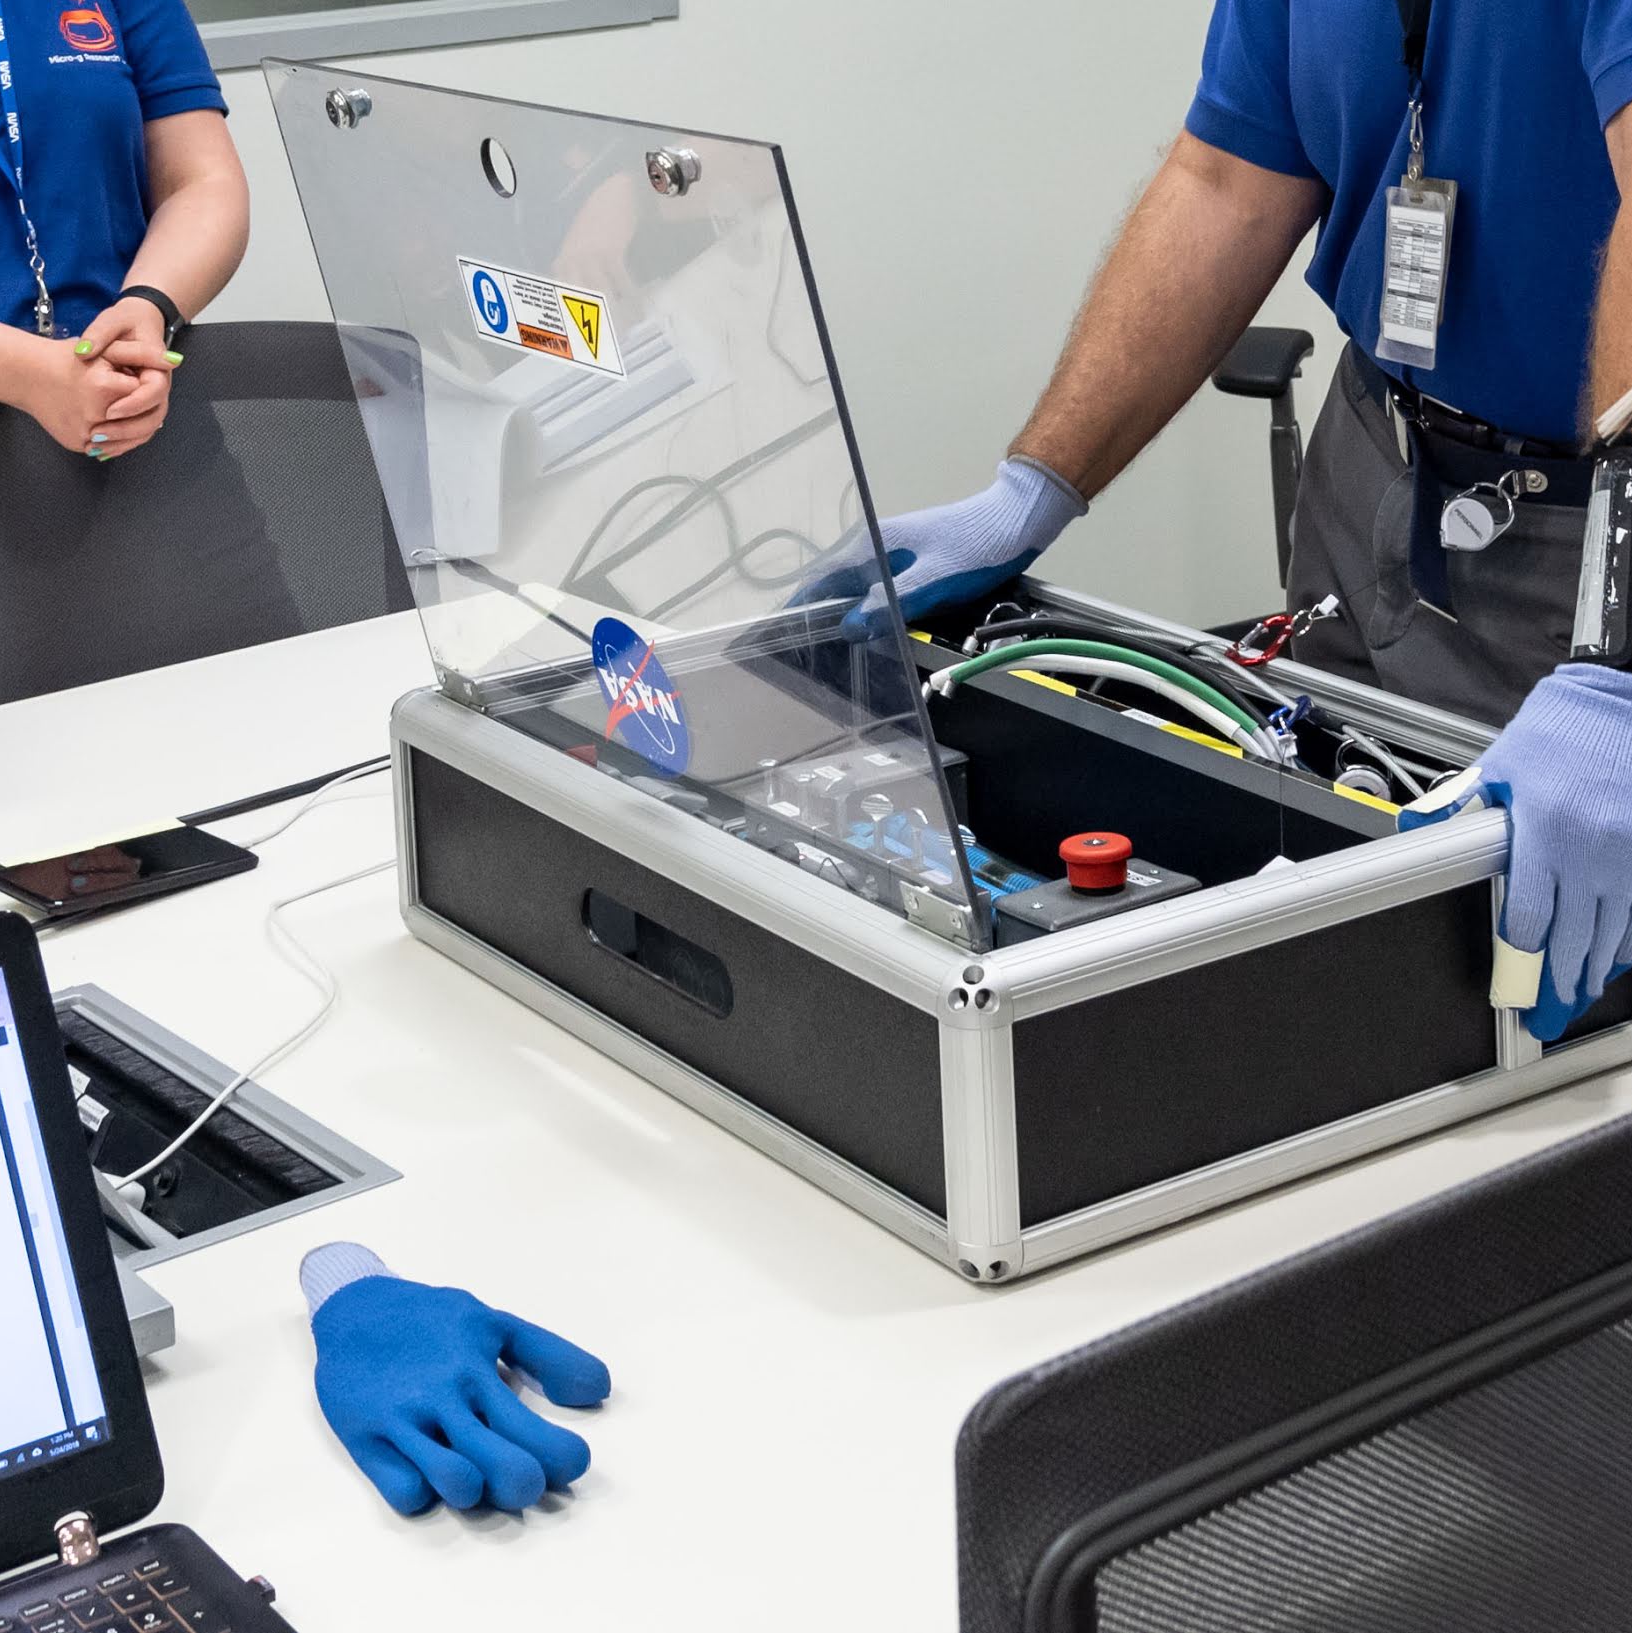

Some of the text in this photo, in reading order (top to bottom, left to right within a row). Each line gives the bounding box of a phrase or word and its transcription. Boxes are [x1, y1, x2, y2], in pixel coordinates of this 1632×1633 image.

[48, 55, 85, 65] Micro-g
[7, 112, 20, 143] NASA
[520, 328, 563, 352] WARNING
[598, 667, 681, 726] NASA
